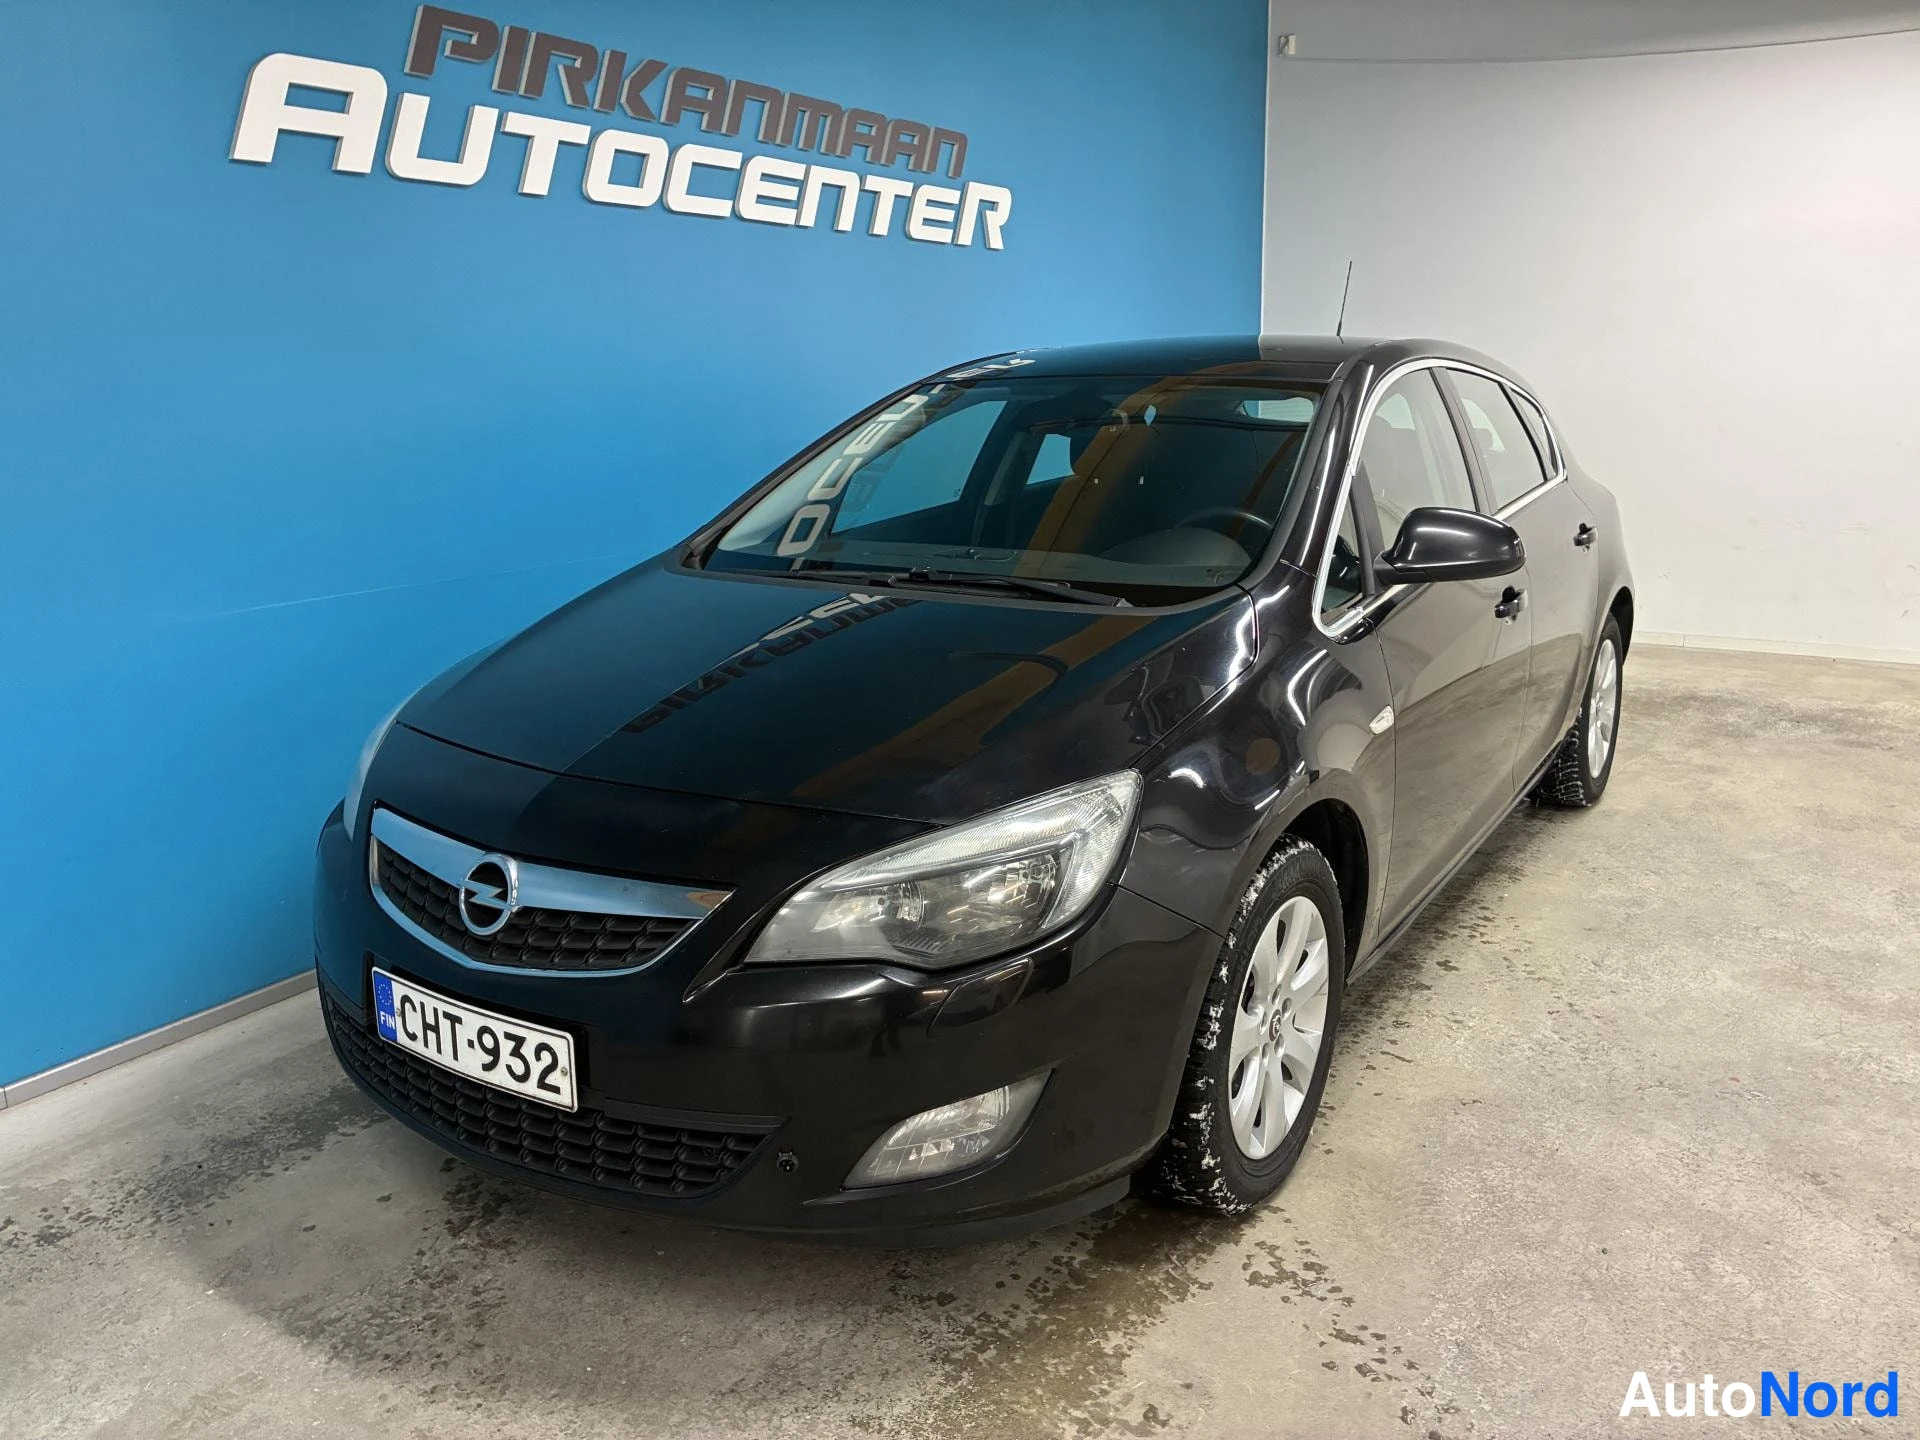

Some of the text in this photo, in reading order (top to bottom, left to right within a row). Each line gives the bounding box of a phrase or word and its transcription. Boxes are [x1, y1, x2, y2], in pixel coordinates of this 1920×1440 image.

[229, 53, 1012, 250] AUTOCENTER
[404, 5, 968, 178] PIRKANMAAN
[380, 1011, 396, 1030] FIN
[400, 994, 561, 1095] CHT-932
